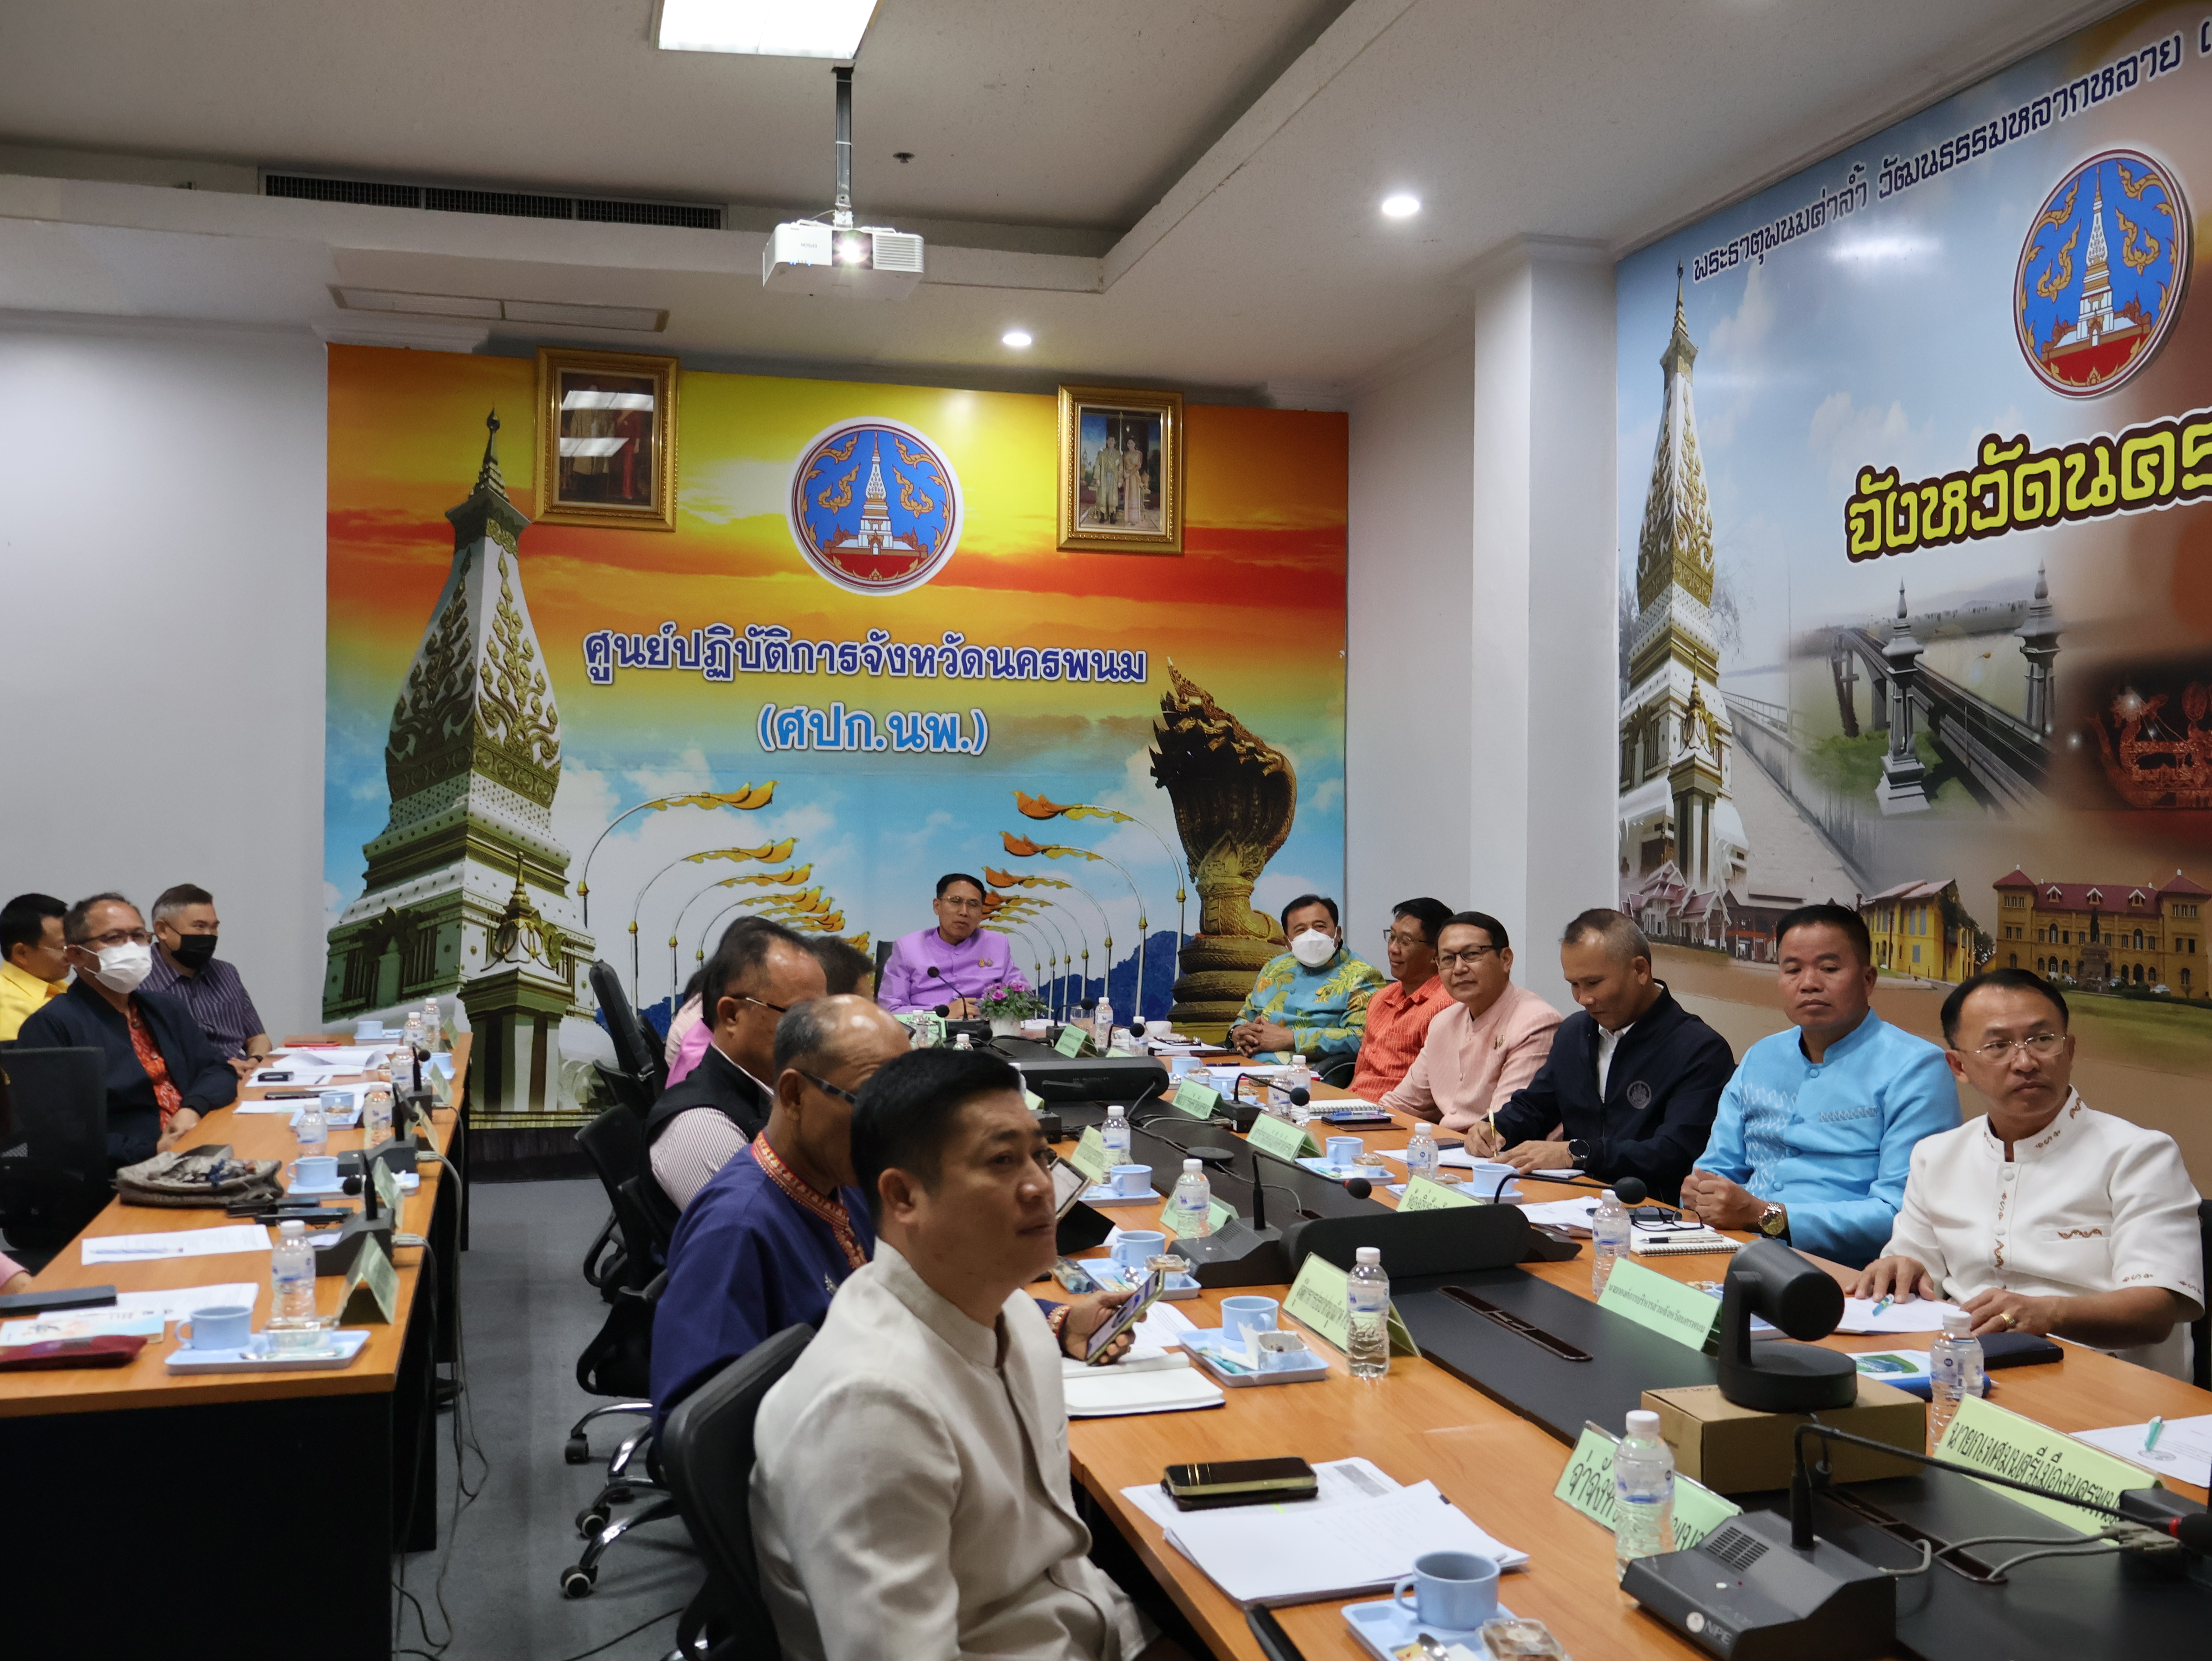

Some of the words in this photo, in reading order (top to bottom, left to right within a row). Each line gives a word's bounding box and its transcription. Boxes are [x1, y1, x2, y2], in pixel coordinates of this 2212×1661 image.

[1694, 165, 1867, 281] พระธาตุพนมค่าล้ำ
[1879, 35, 2180, 199] วัฒนธรรมหลากหลาย
[586, 624, 1144, 681] ศูนย์ปฏิบัติการจังหวัดนครพนม
[761, 705, 985, 752] (ศปก.นพ.)
